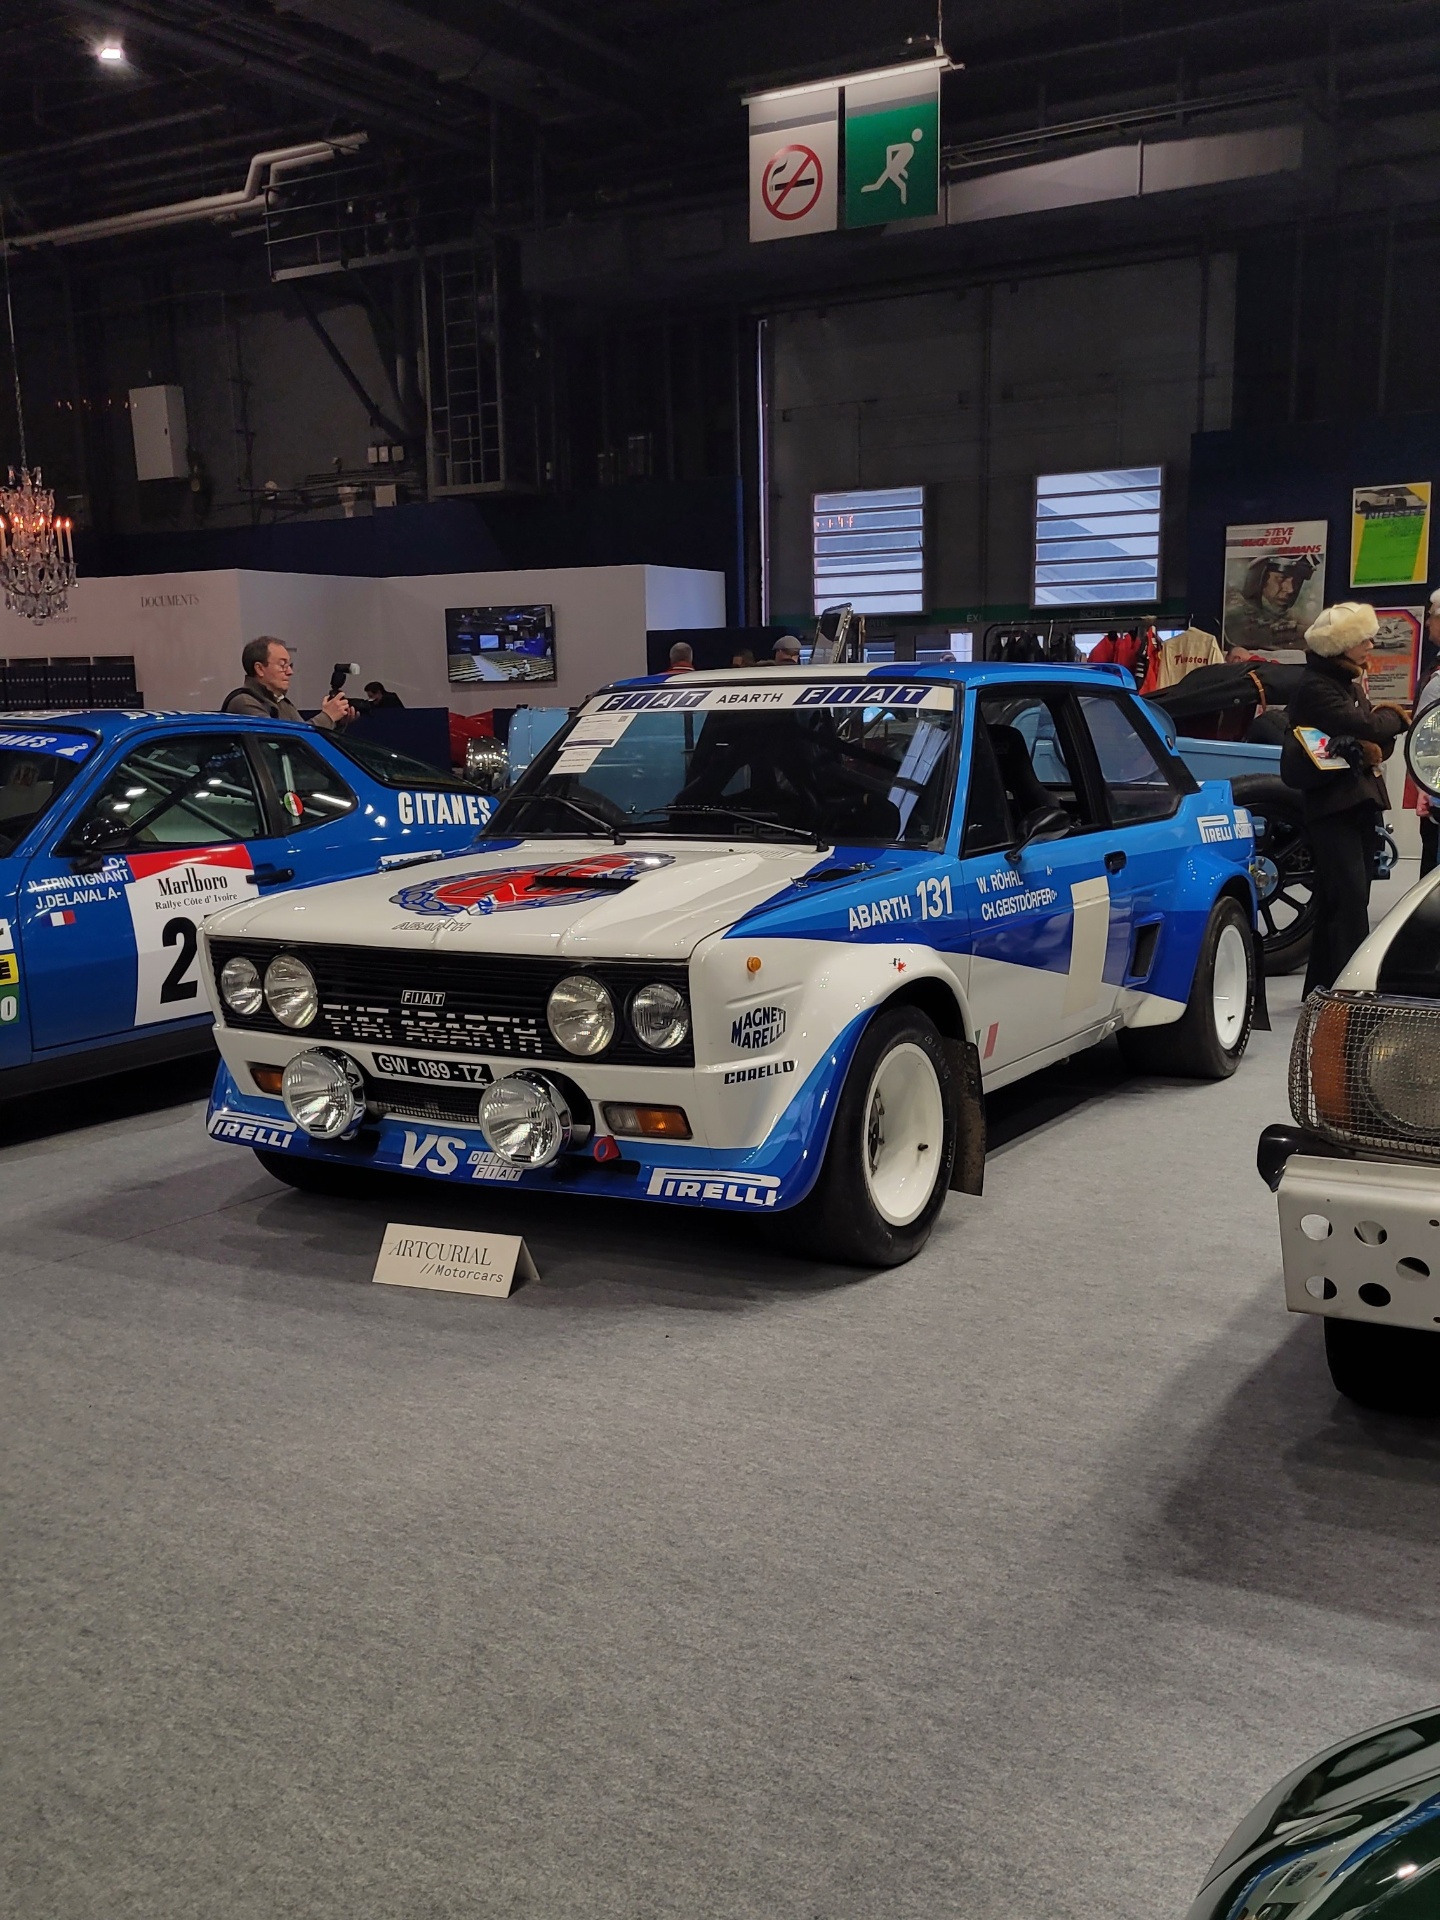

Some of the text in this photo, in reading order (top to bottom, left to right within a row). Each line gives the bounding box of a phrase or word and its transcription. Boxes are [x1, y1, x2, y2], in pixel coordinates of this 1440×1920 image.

[1265, 527, 1294, 536] STEVE
[140, 594, 200, 608] DOCUMENTS
[599, 686, 932, 712] FIAT ABARTH FIAT
[397, 792, 492, 826] GITANES
[1197, 815, 1233, 844] PIRELLI
[157, 867, 228, 896] Marlboro
[976, 876, 990, 894] W.
[990, 869, 1024, 892] RÖHRL
[155, 901, 183, 910] Rallye
[183, 898, 203, 907] Côte
[214, 893, 238, 903] Ivoire
[849, 875, 953, 932] ABARTH 131
[402, 990, 445, 1006] FIAT
[323, 1003, 543, 1054] FIAT ABARTH
[724, 1060, 795, 1085] CARELLO
[207, 1110, 298, 1149] PIRELLI
[402, 1131, 466, 1175] VS
[475, 1166, 522, 1180] FIAT
[647, 1168, 781, 1207] PIRELLI
[389, 1239, 491, 1266] ARTCURIAL
